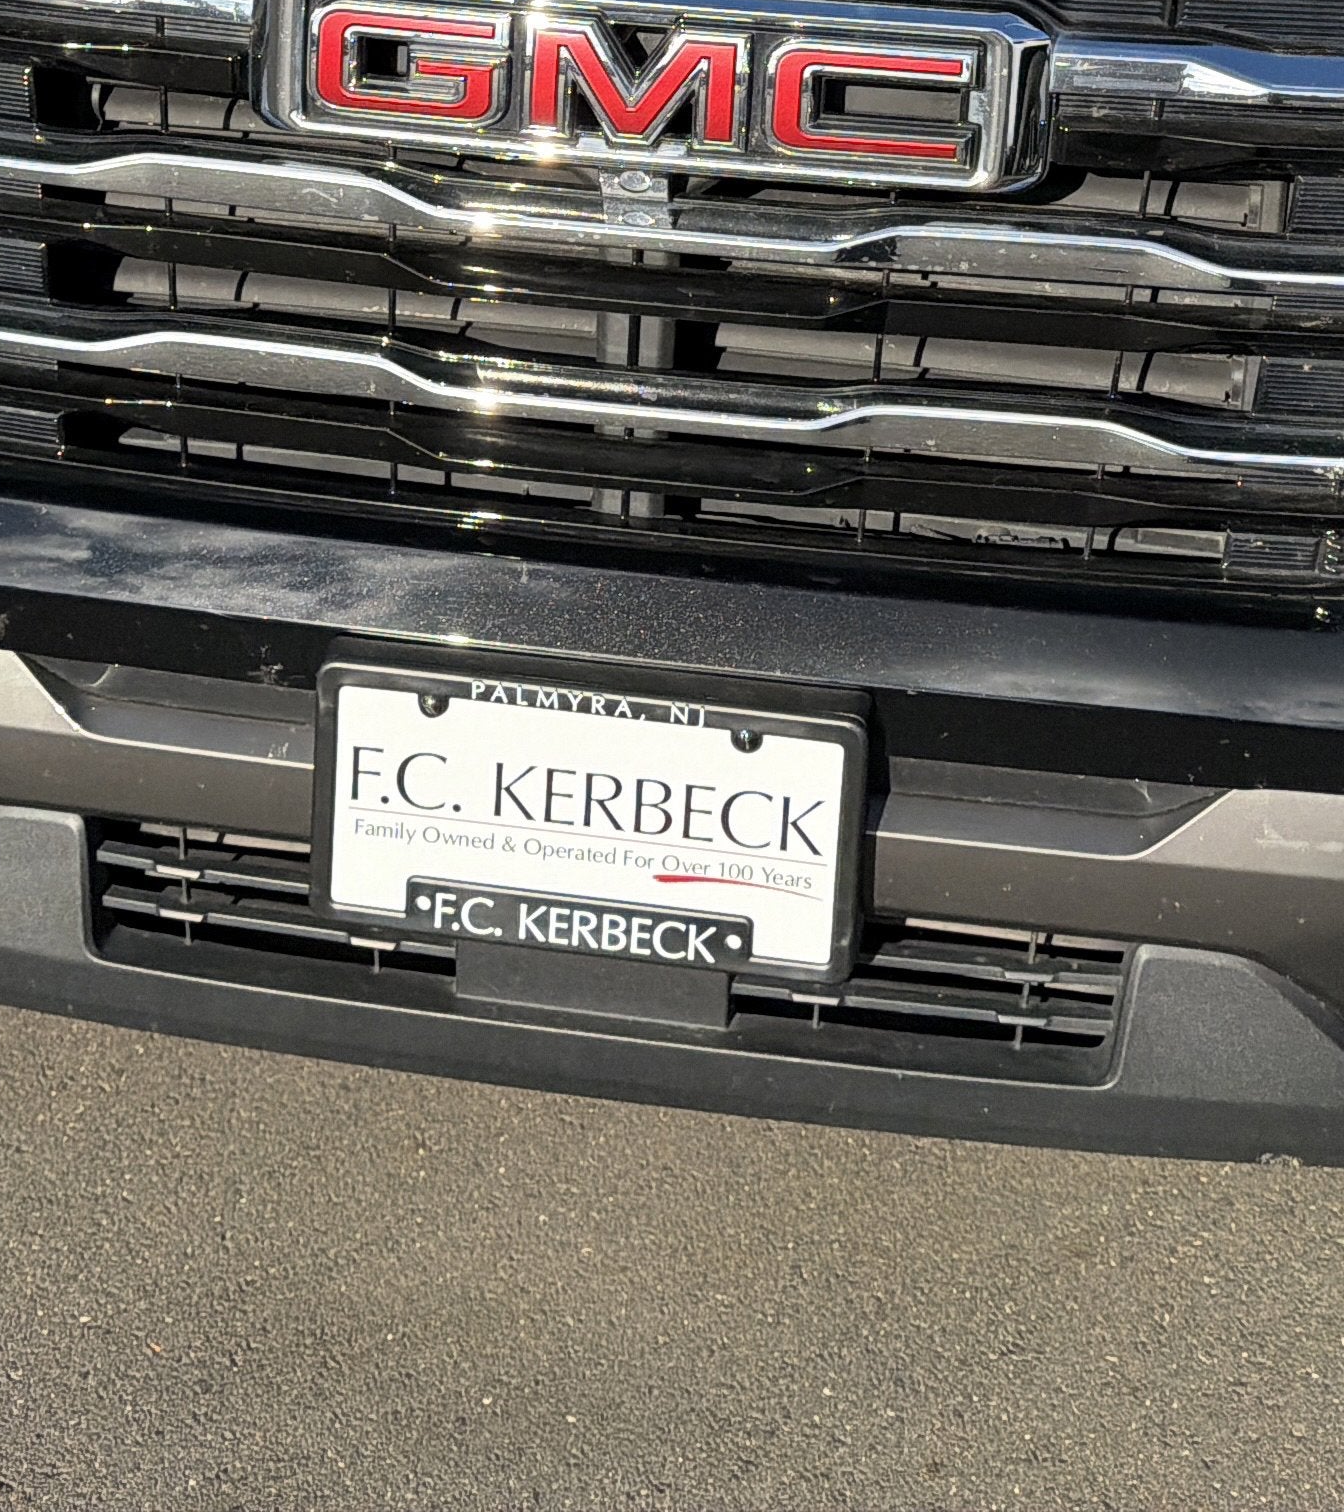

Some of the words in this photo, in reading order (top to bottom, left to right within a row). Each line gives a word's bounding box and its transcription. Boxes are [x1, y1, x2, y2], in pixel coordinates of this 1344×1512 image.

[470, 680, 646, 721] PALMYRA,
[669, 701, 706, 729] NJ
[351, 745, 462, 814] F.C.
[493, 762, 826, 857] KERBECK
[354, 818, 416, 845] Family
[422, 826, 495, 850] Owned
[501, 836, 517, 853] &
[523, 837, 617, 865] Operated
[623, 849, 655, 870] For
[661, 854, 711, 876] Over
[718, 861, 754, 881] 100
[761, 866, 813, 890] Years
[433, 892, 503, 937] F.C.
[518, 902, 717, 964] KERBECK
